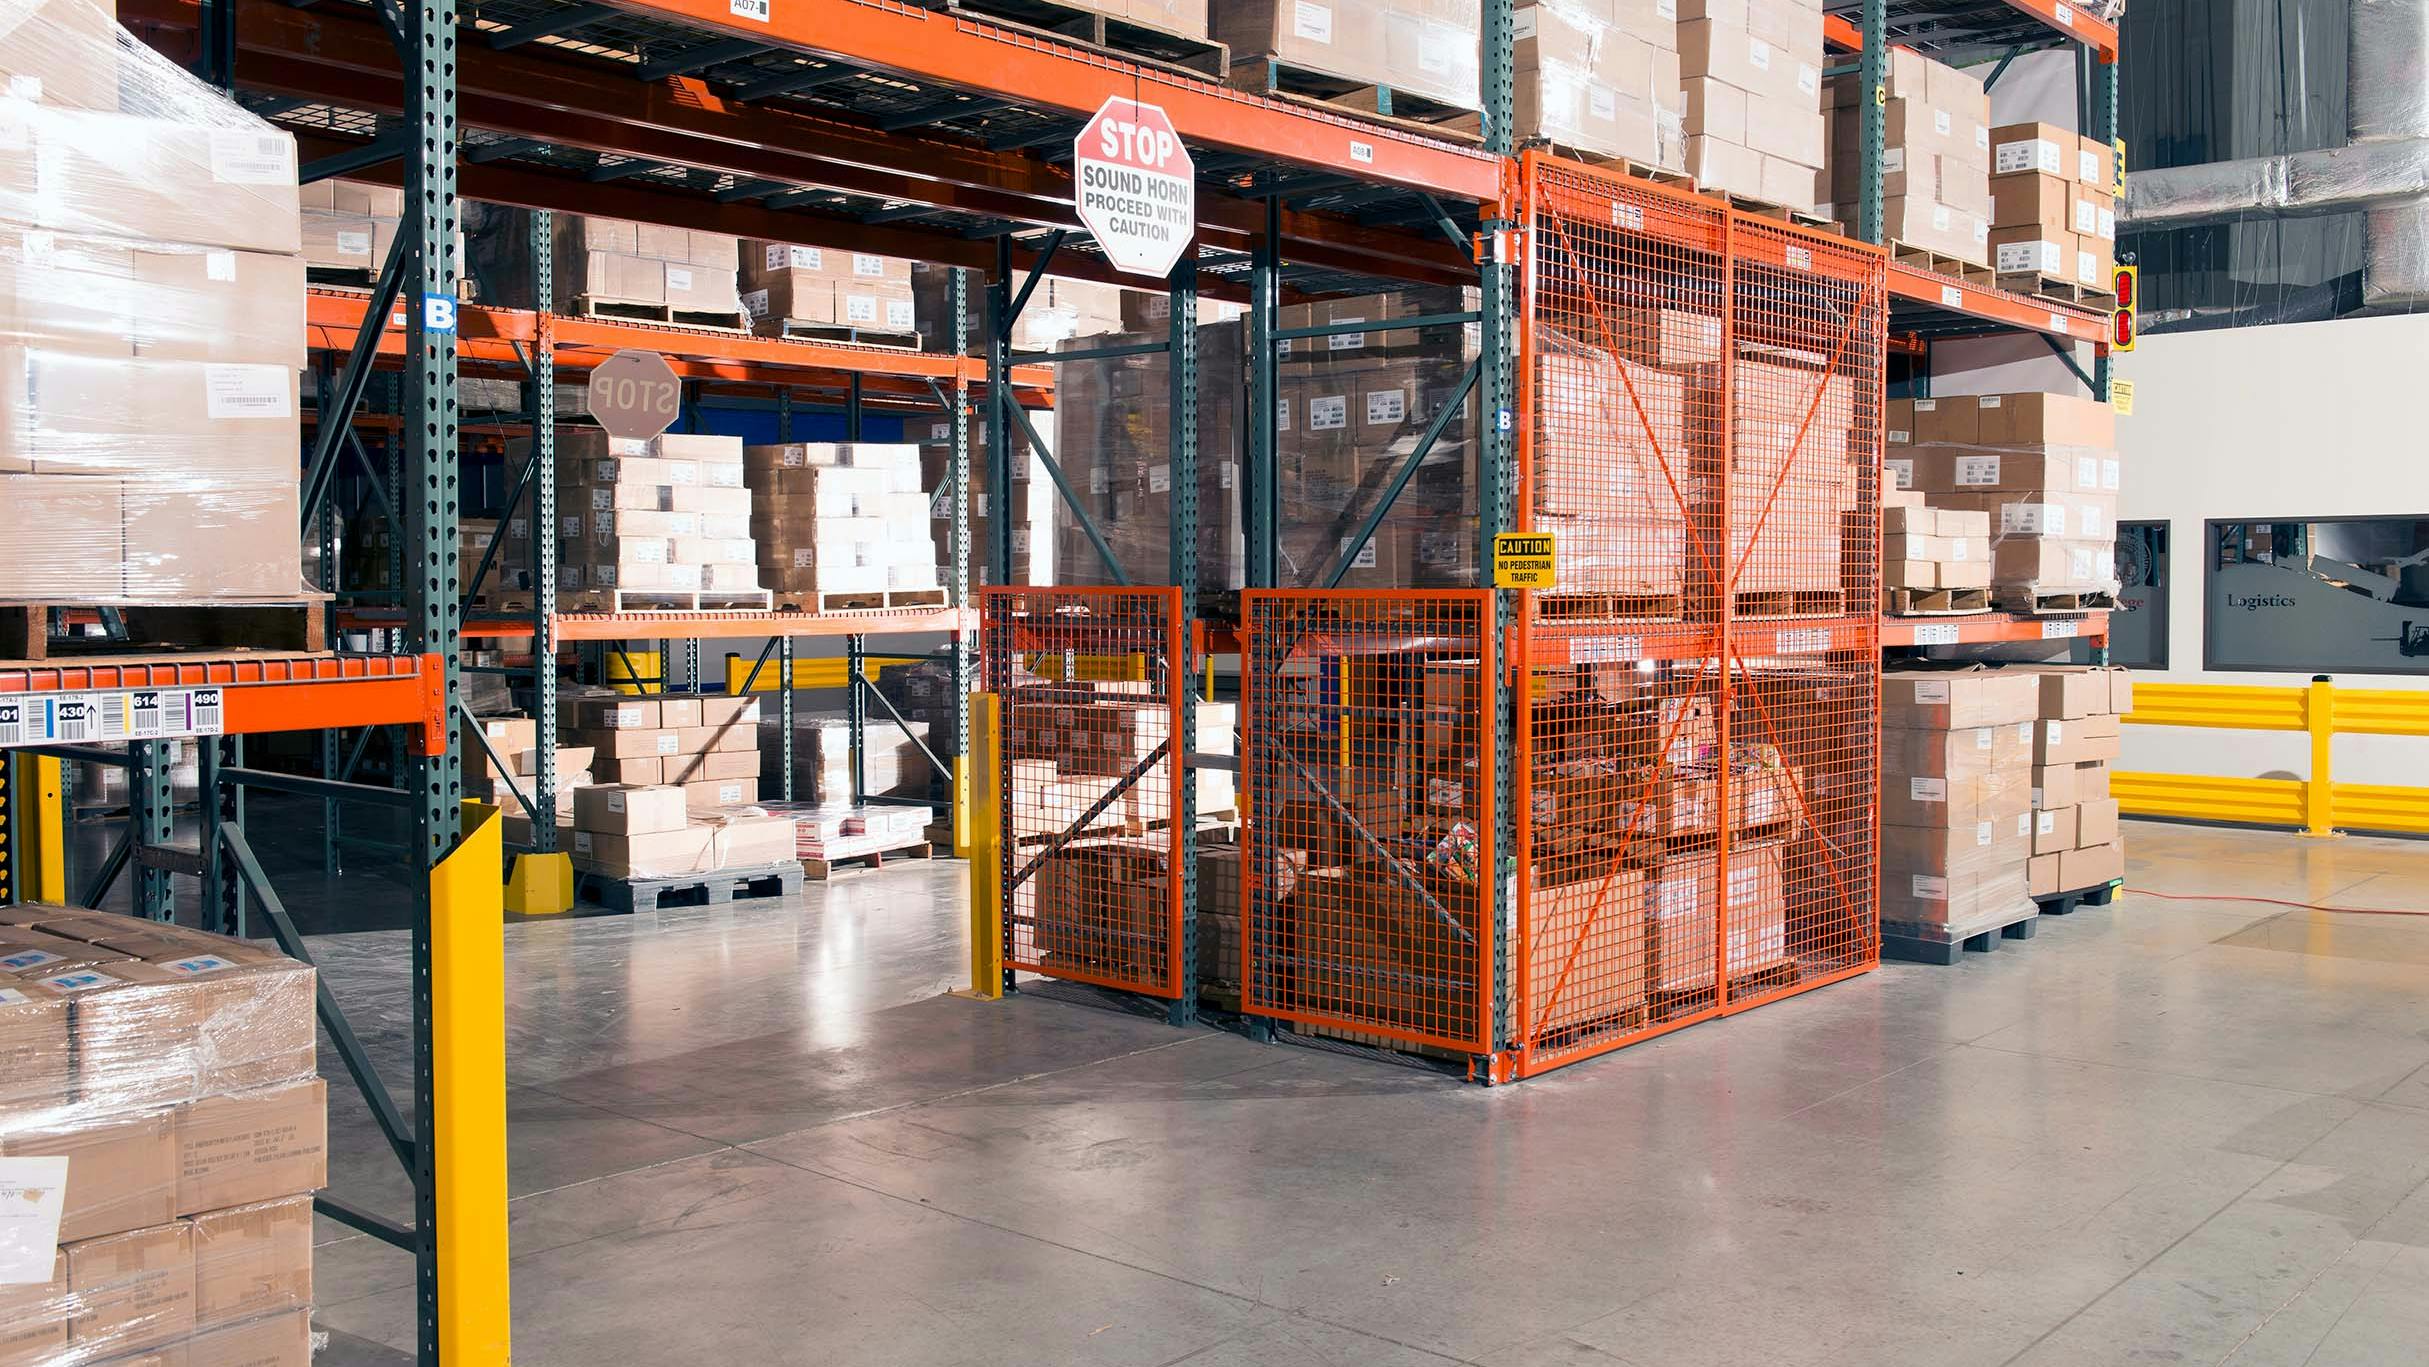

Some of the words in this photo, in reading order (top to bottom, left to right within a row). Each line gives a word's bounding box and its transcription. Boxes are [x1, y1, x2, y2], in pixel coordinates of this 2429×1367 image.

[1101, 117, 1173, 168] STOP
[1084, 165, 1142, 195] SOUND
[1147, 177, 1188, 206] HORN
[1085, 192, 1153, 217] PROCEED
[1157, 205, 1187, 226] WITH
[1109, 217, 1169, 242] CAUTION
[426, 298, 454, 329] B
[1500, 410, 1511, 430] B
[1500, 540, 1550, 553] CAUTION
[1499, 560, 1508, 570] NO
[1510, 560, 1551, 570] PEDESTRIAN
[1511, 573, 1538, 582] TRAFFIC
[2228, 593, 2296, 611] Logistics
[134, 695, 158, 707] 614
[195, 693, 218, 704] 490
[0, 709, 18, 721] 01
[60, 706, 84, 718] 430
